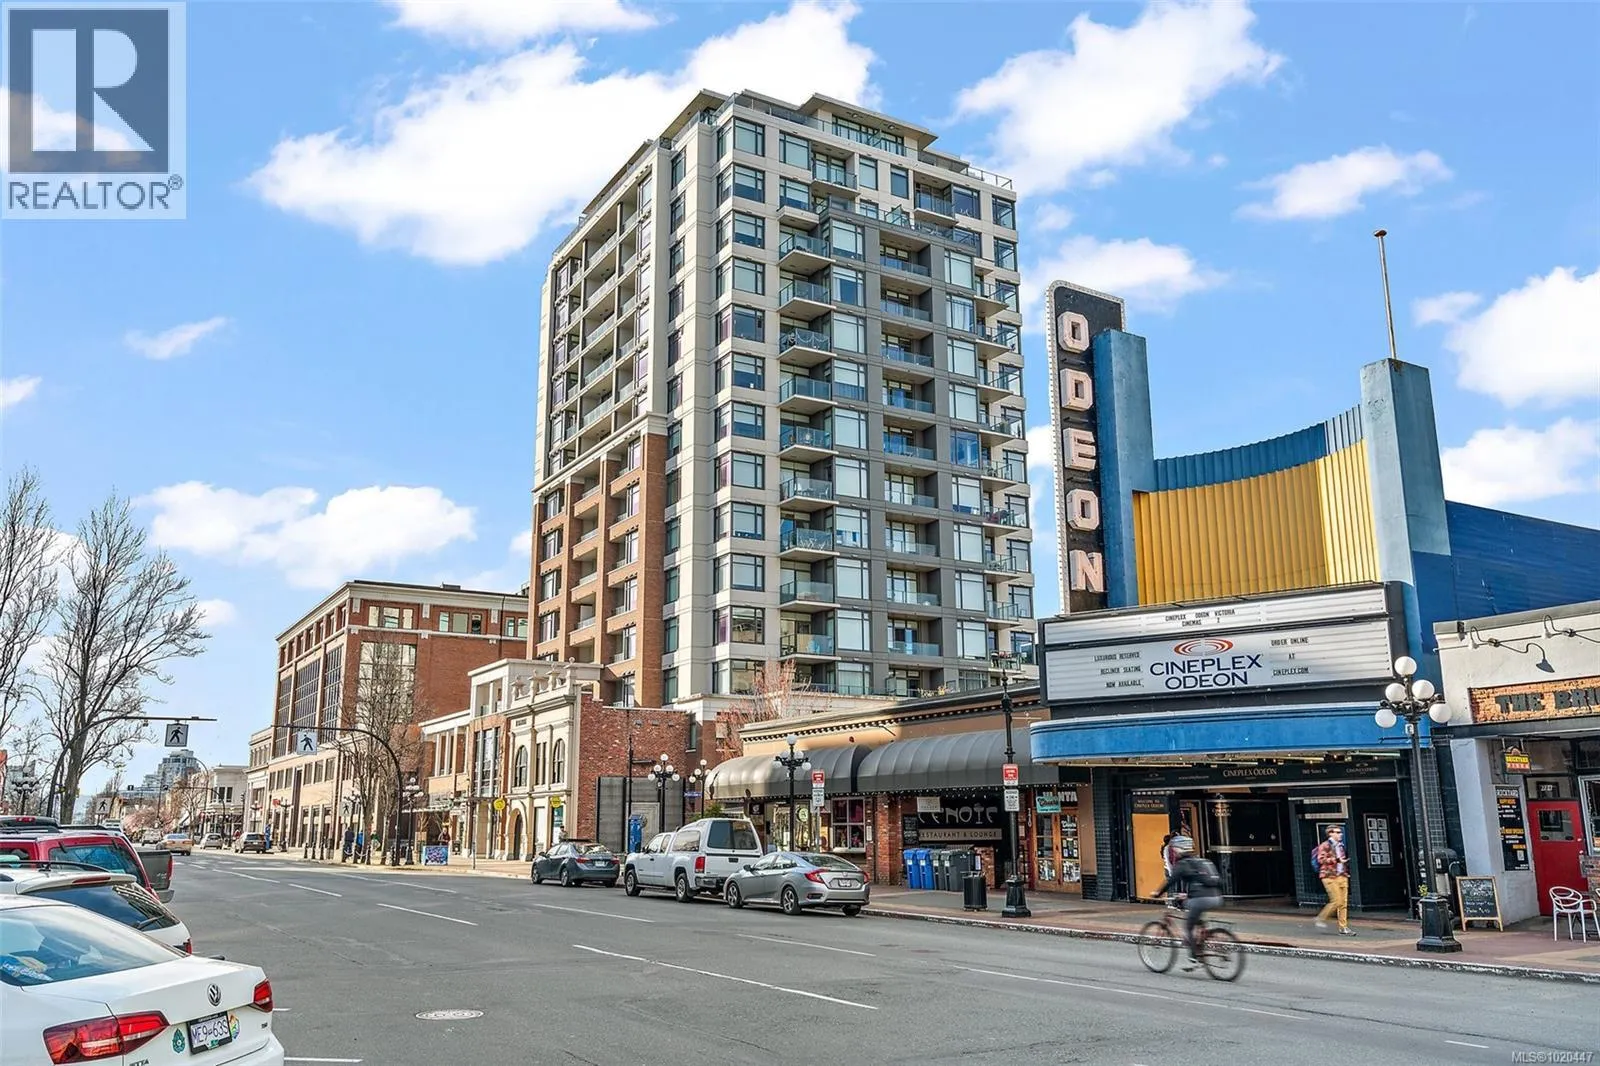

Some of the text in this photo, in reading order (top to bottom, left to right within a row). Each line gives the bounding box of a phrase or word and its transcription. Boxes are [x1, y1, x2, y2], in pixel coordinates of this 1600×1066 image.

[1056, 311, 1106, 593] ODEON
[1165, 608, 1236, 622] CINEPLEX ODEON VICTORIA
[1181, 619, 1202, 627] CINEMAS
[1271, 636, 1309, 647] ORDER ONLINE
[1288, 652, 1296, 660] AT
[1150, 654, 1263, 676] CINEPLEX
[1165, 671, 1248, 690] ODEON
[1494, 692, 1545, 714] THE
[1223, 767, 1278, 778] CINEPLEX ODEON
[970, 830, 997, 838] LOUNGE
